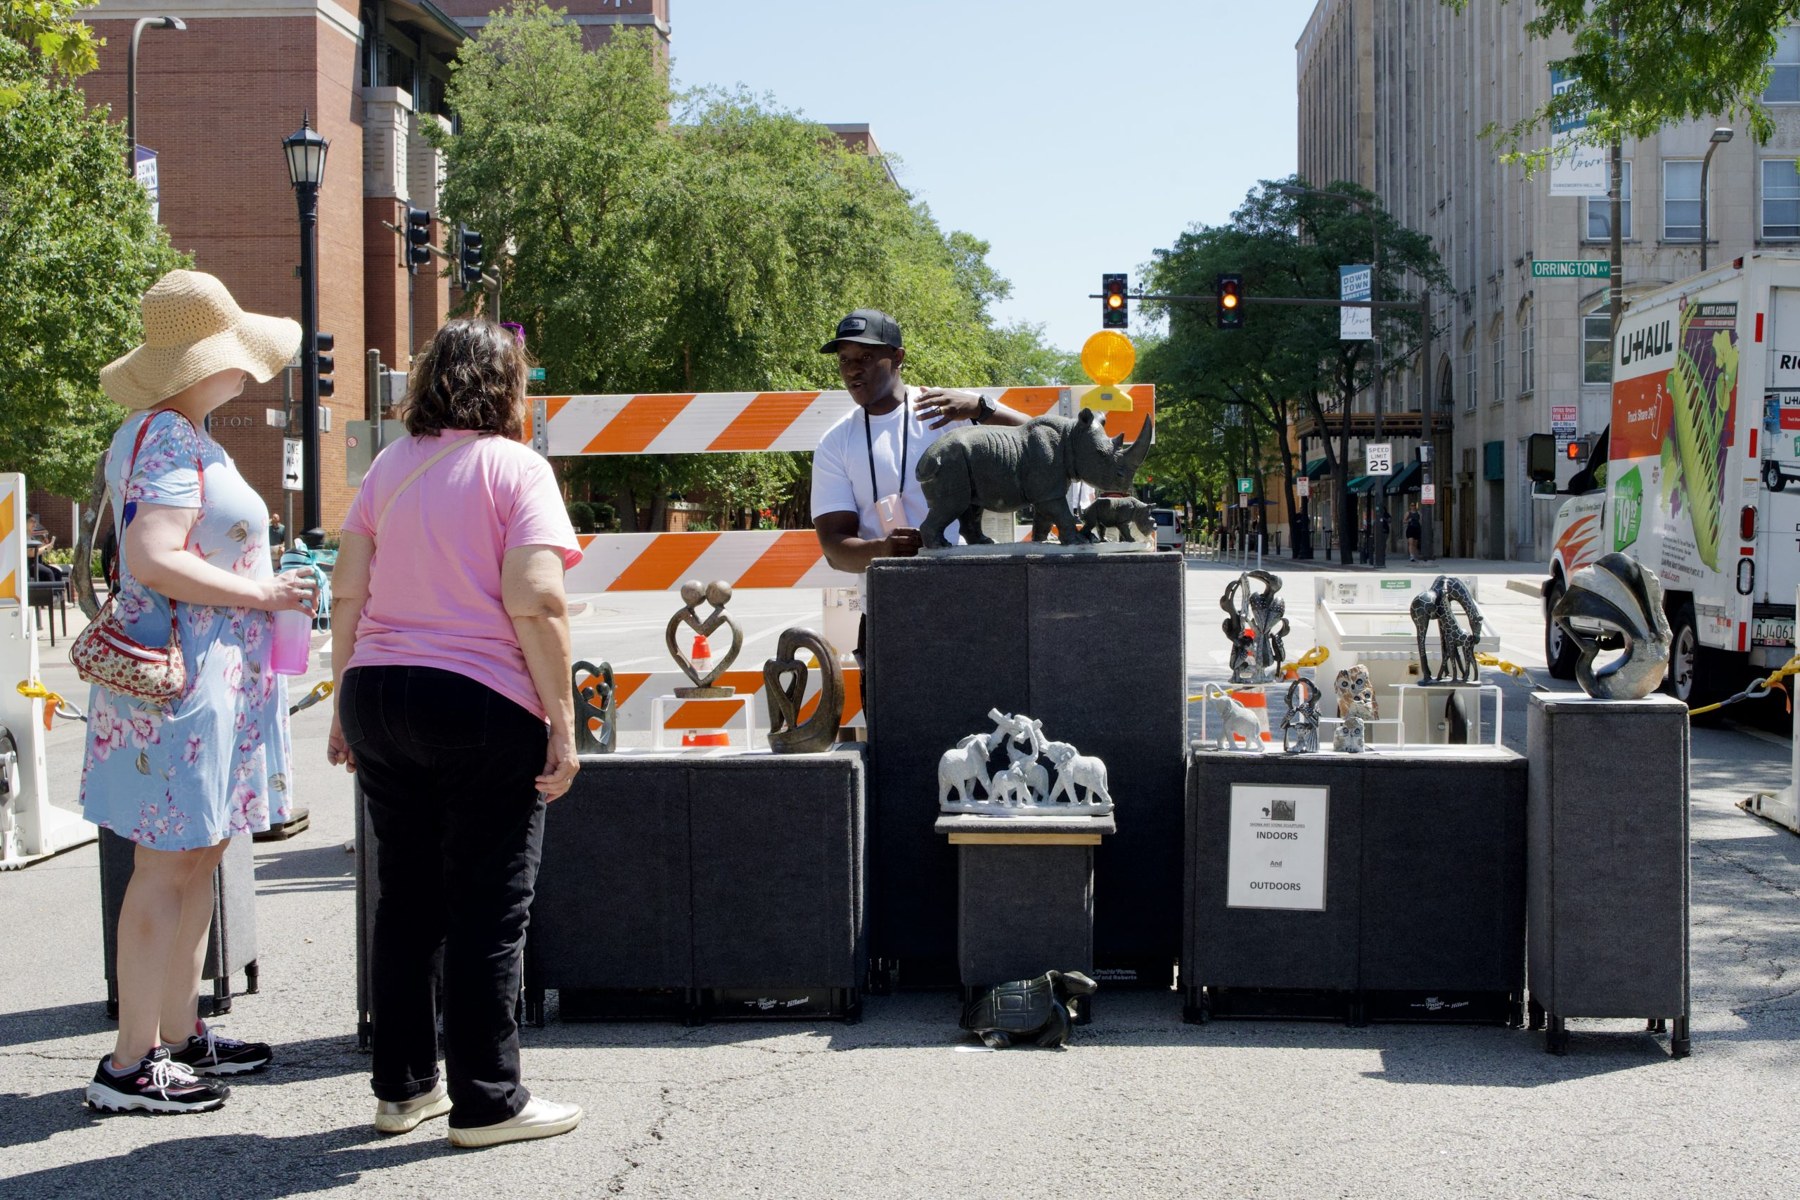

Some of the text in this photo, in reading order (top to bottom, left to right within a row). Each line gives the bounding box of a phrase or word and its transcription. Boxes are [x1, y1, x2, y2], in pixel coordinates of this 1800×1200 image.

[1534, 262, 1598, 276] ORRINGTON
[1343, 271, 1369, 285] DOWN
[1343, 280, 1369, 293] TOWN
[1702, 305, 1736, 315] NORTH CAROLINA
[1621, 320, 1673, 366] U-HAUL
[1370, 460, 1389, 471] 25
[1256, 831, 1299, 840] INDOORS
[1270, 860, 1283, 868] And
[1249, 881, 1302, 891] OUTDOORS
